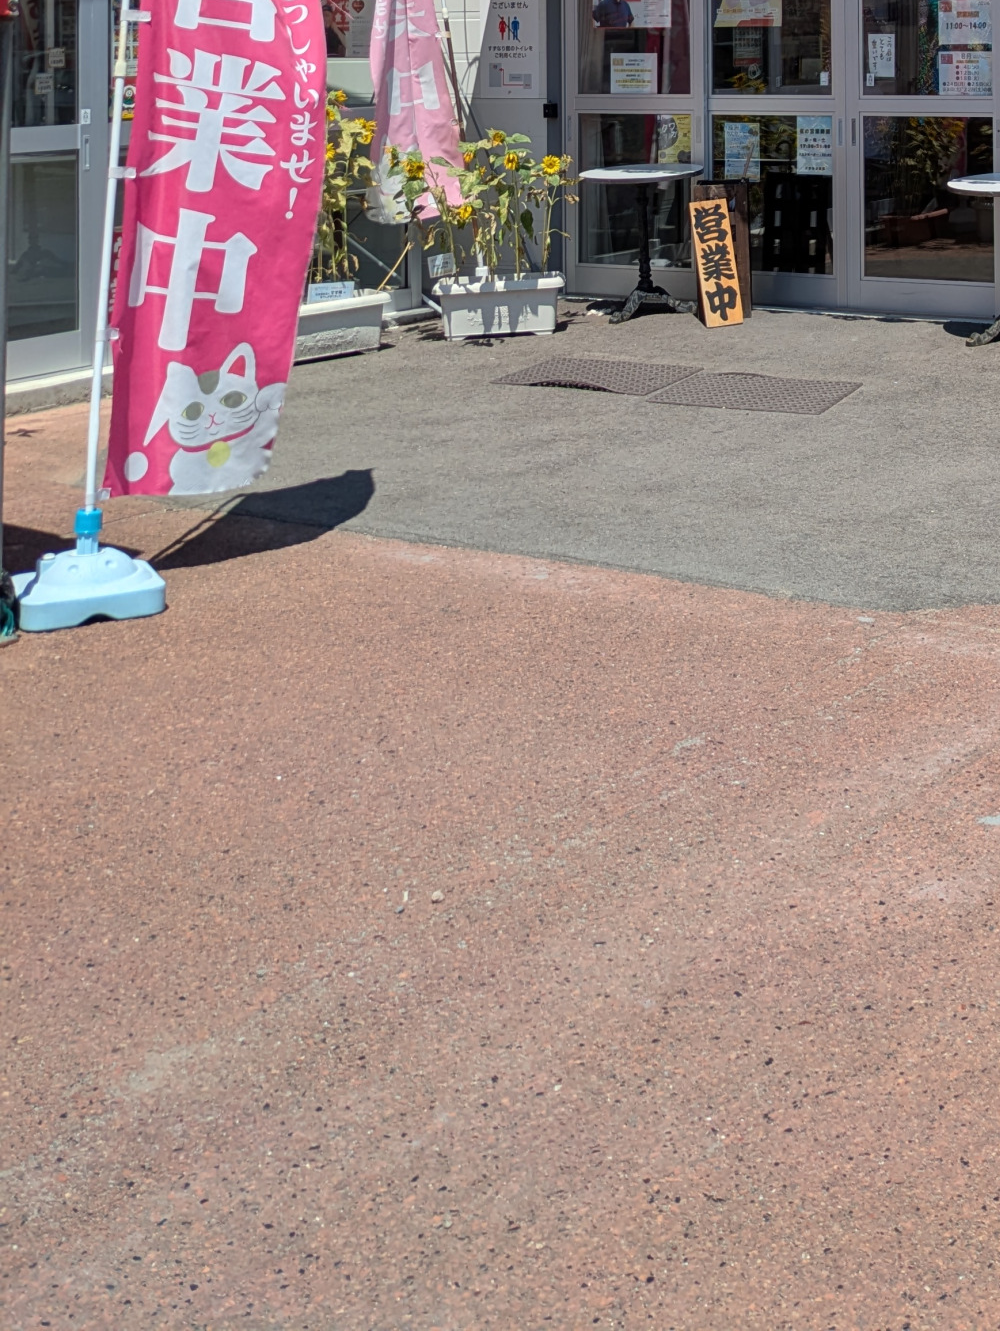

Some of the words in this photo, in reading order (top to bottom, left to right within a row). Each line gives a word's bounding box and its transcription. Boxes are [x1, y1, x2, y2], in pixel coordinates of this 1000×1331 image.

[491, 1, 529, 9] ございません
[693, 203, 739, 322] 営業中
